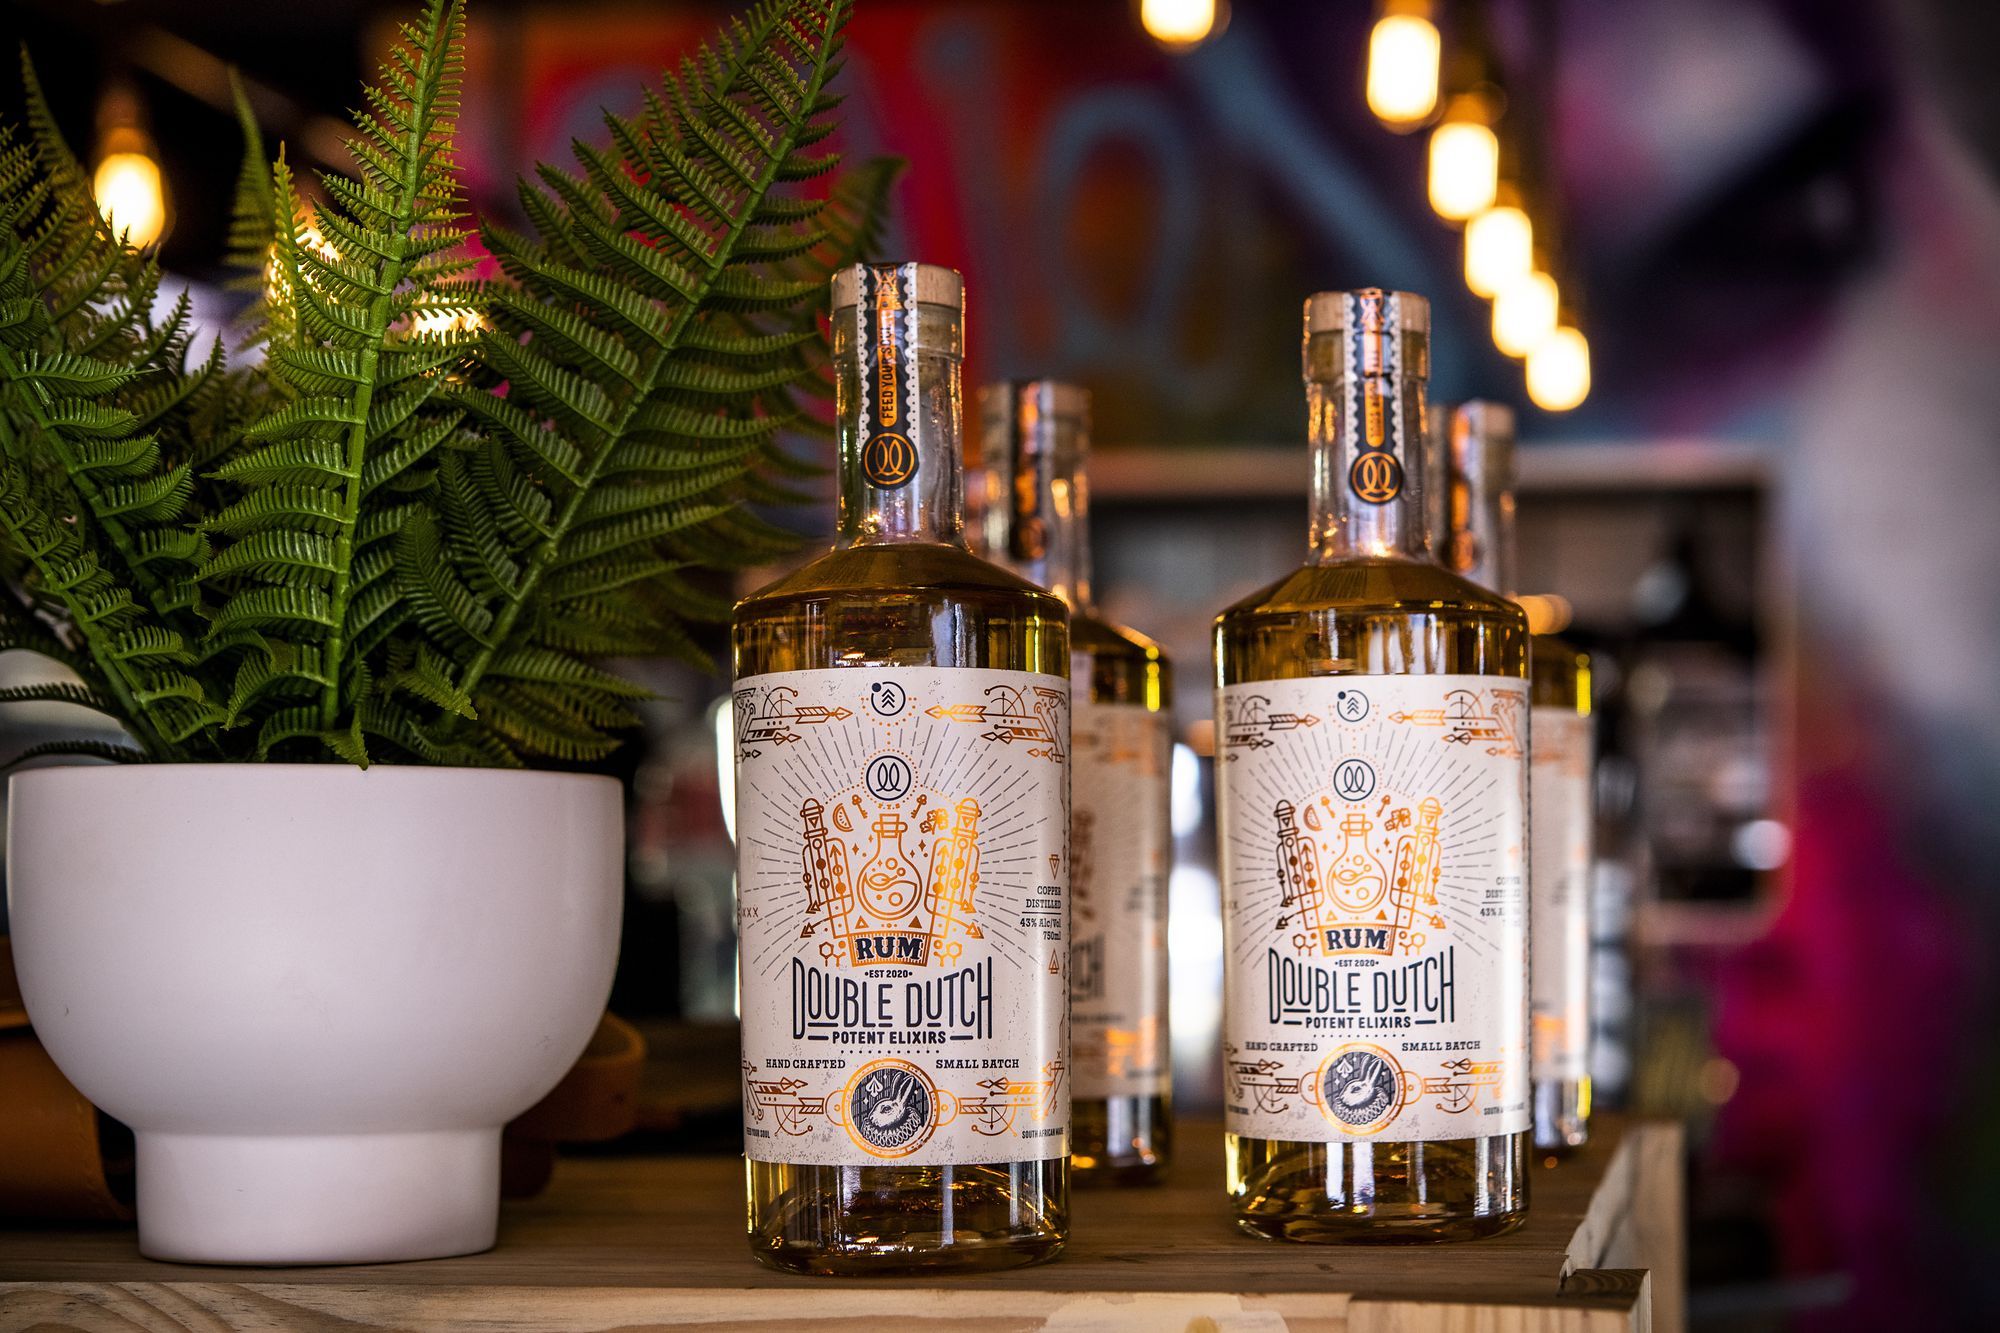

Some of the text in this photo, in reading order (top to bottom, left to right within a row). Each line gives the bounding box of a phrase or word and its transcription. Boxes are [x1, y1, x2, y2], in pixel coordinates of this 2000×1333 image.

[882, 356, 894, 391] YOUR
[882, 391, 894, 419] FEED
[1026, 899, 1061, 908] DISTILLED
[1480, 908, 1496, 916] 43%
[1020, 918, 1037, 927] 43%
[1043, 931, 1062, 940] 750ml
[1326, 928, 1388, 950] RUM
[854, 936, 924, 960] RUM
[869, 970, 908, 978] EST 2020
[1268, 946, 1454, 1024] DOUBLE DUTCH
[792, 956, 893, 1040] DOUBLE
[906, 956, 992, 1040] DUTCH
[1306, 1016, 1412, 1028] POTENT ELIXIRS
[832, 1030, 946, 1044] POTENT ELIXIRS
[1246, 1042, 1318, 1052] HAND CRAFTED
[1402, 1040, 1480, 1052] SMALL BATCH
[766, 1058, 846, 1068] HAND CRAFTED
[936, 1058, 1020, 1068] SMALL BATCH
[1022, 1130, 1038, 1139] SOUTH
